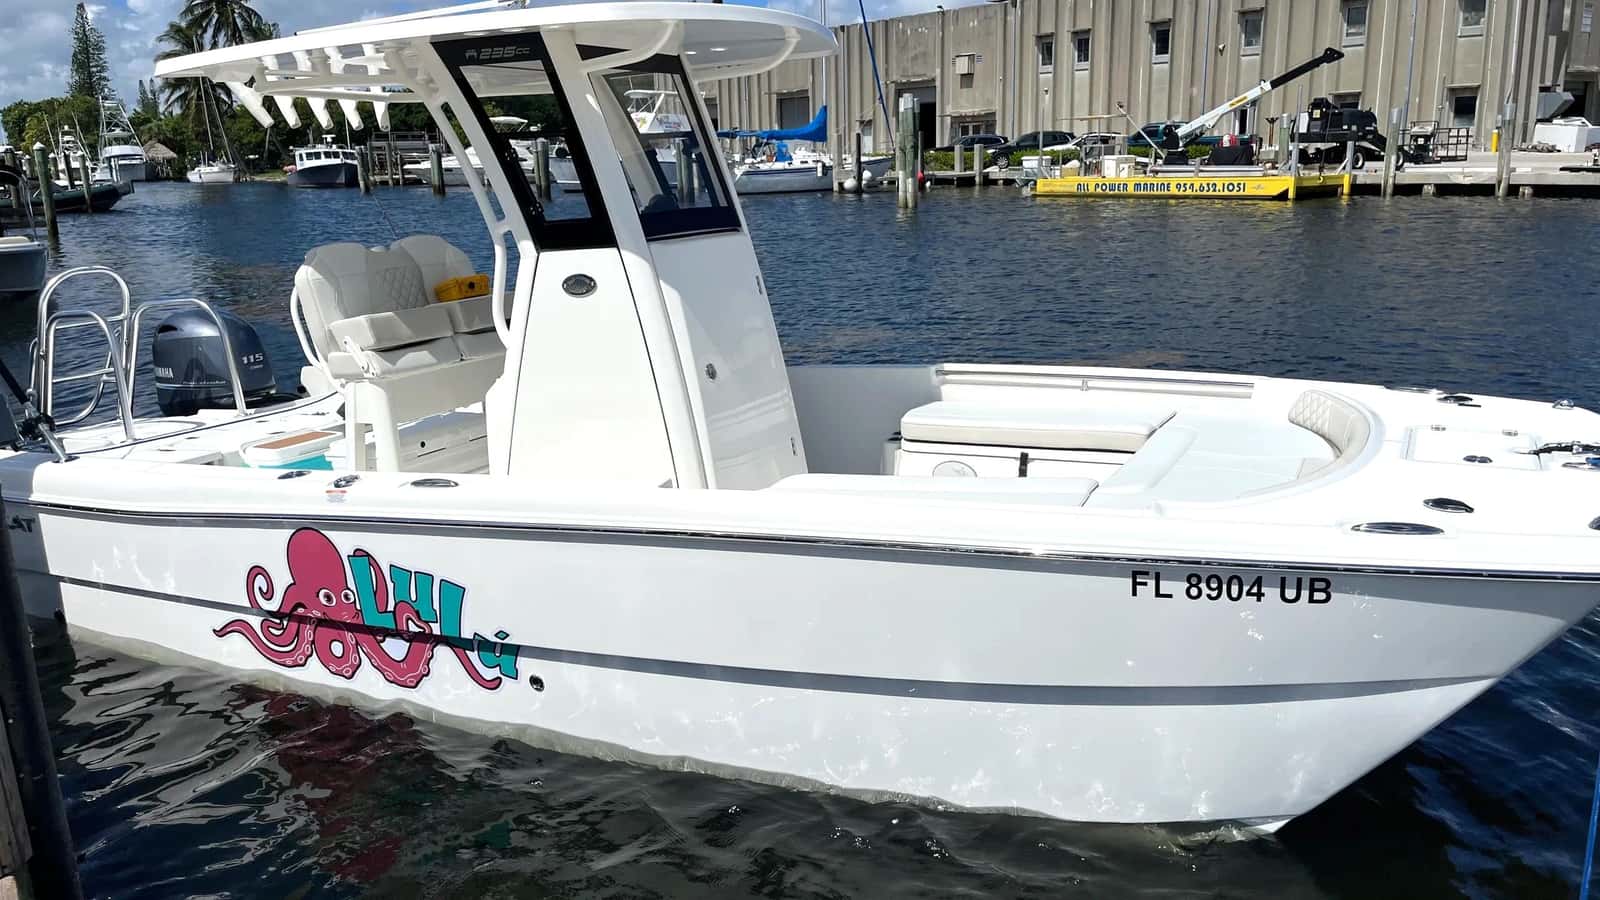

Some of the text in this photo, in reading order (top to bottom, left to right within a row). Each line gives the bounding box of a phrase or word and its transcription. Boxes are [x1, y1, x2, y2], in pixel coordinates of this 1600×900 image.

[1076, 182, 1246, 193] ALL POWER MARINE 954.632.1051
[242, 352, 264, 364] 115
[1131, 570, 1332, 604] FL 8904 UB
